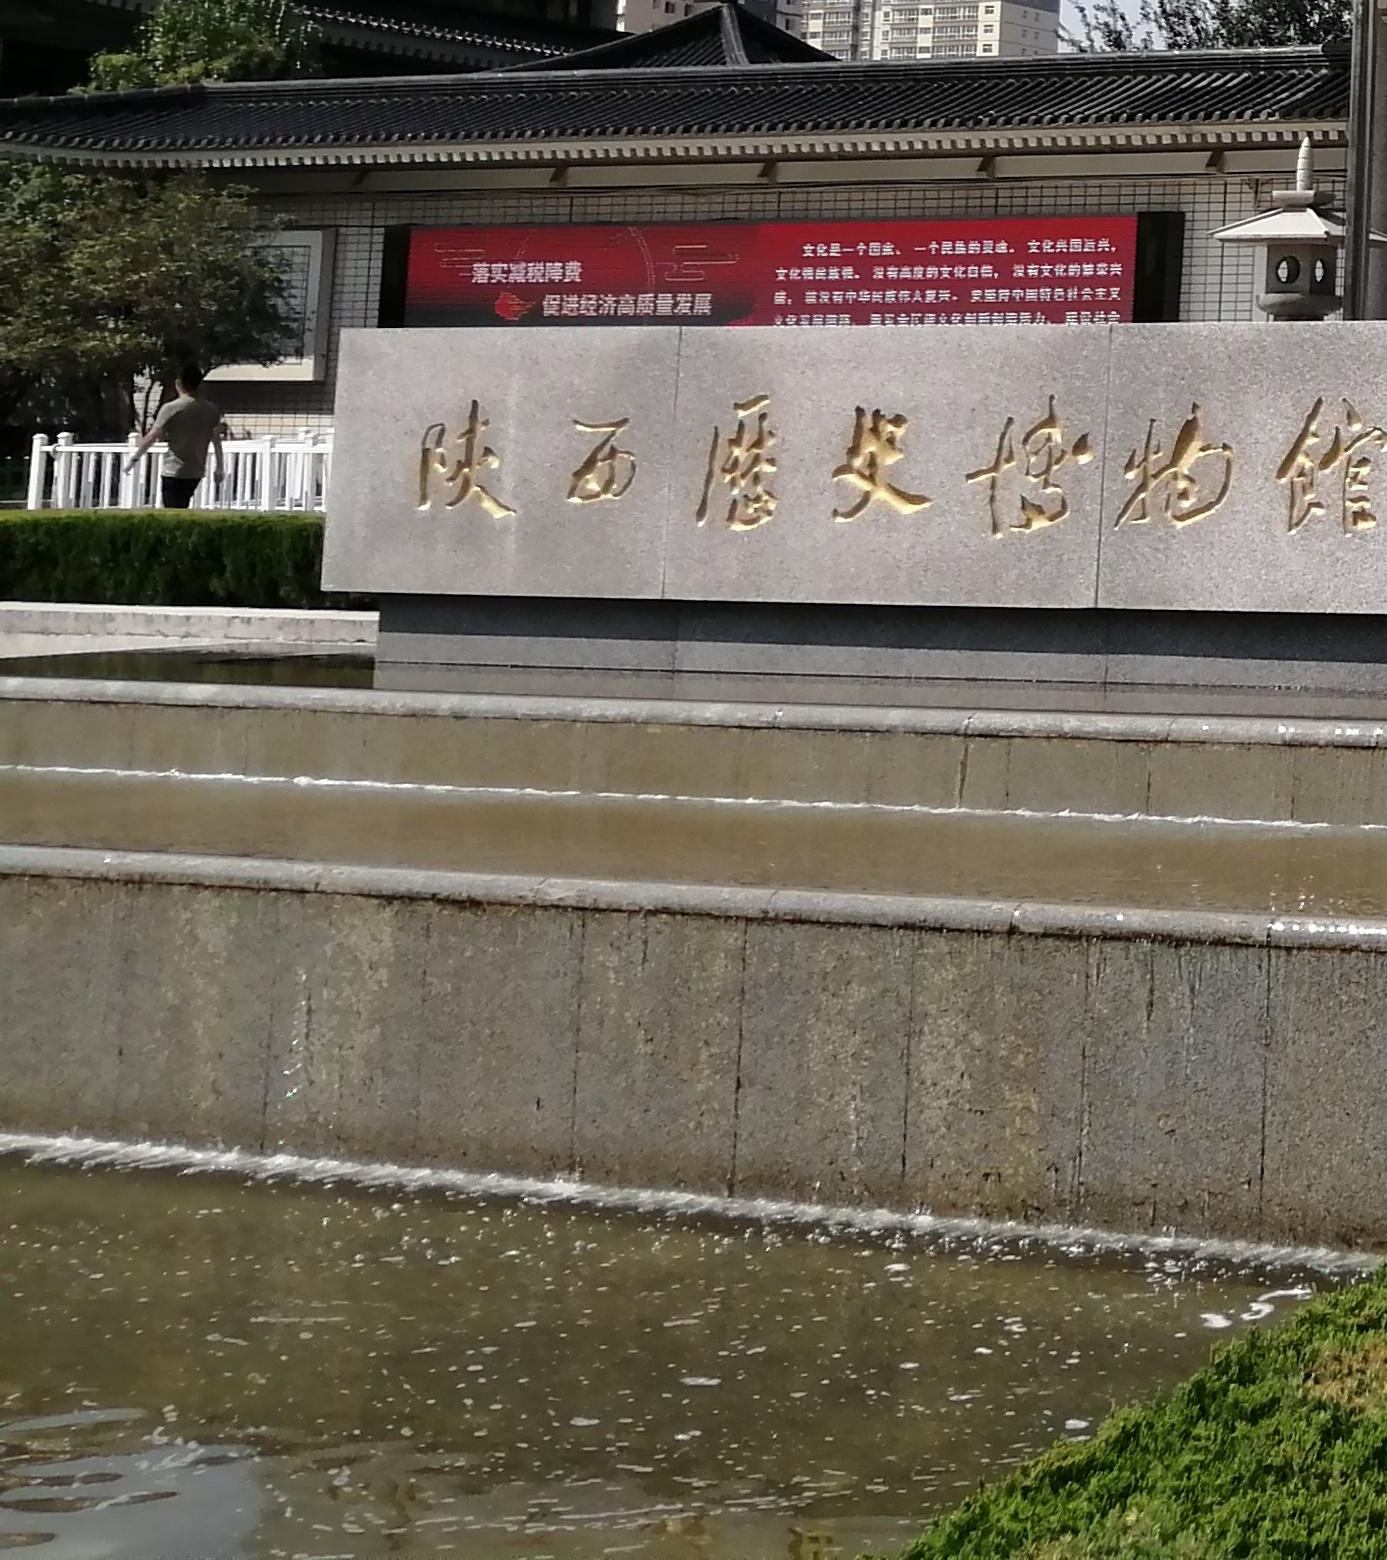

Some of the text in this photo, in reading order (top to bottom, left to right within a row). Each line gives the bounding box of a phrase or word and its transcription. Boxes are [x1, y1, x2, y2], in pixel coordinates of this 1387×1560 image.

[471, 261, 582, 284] 落实减税降费
[542, 293, 712, 316] 促进经济高质量发展
